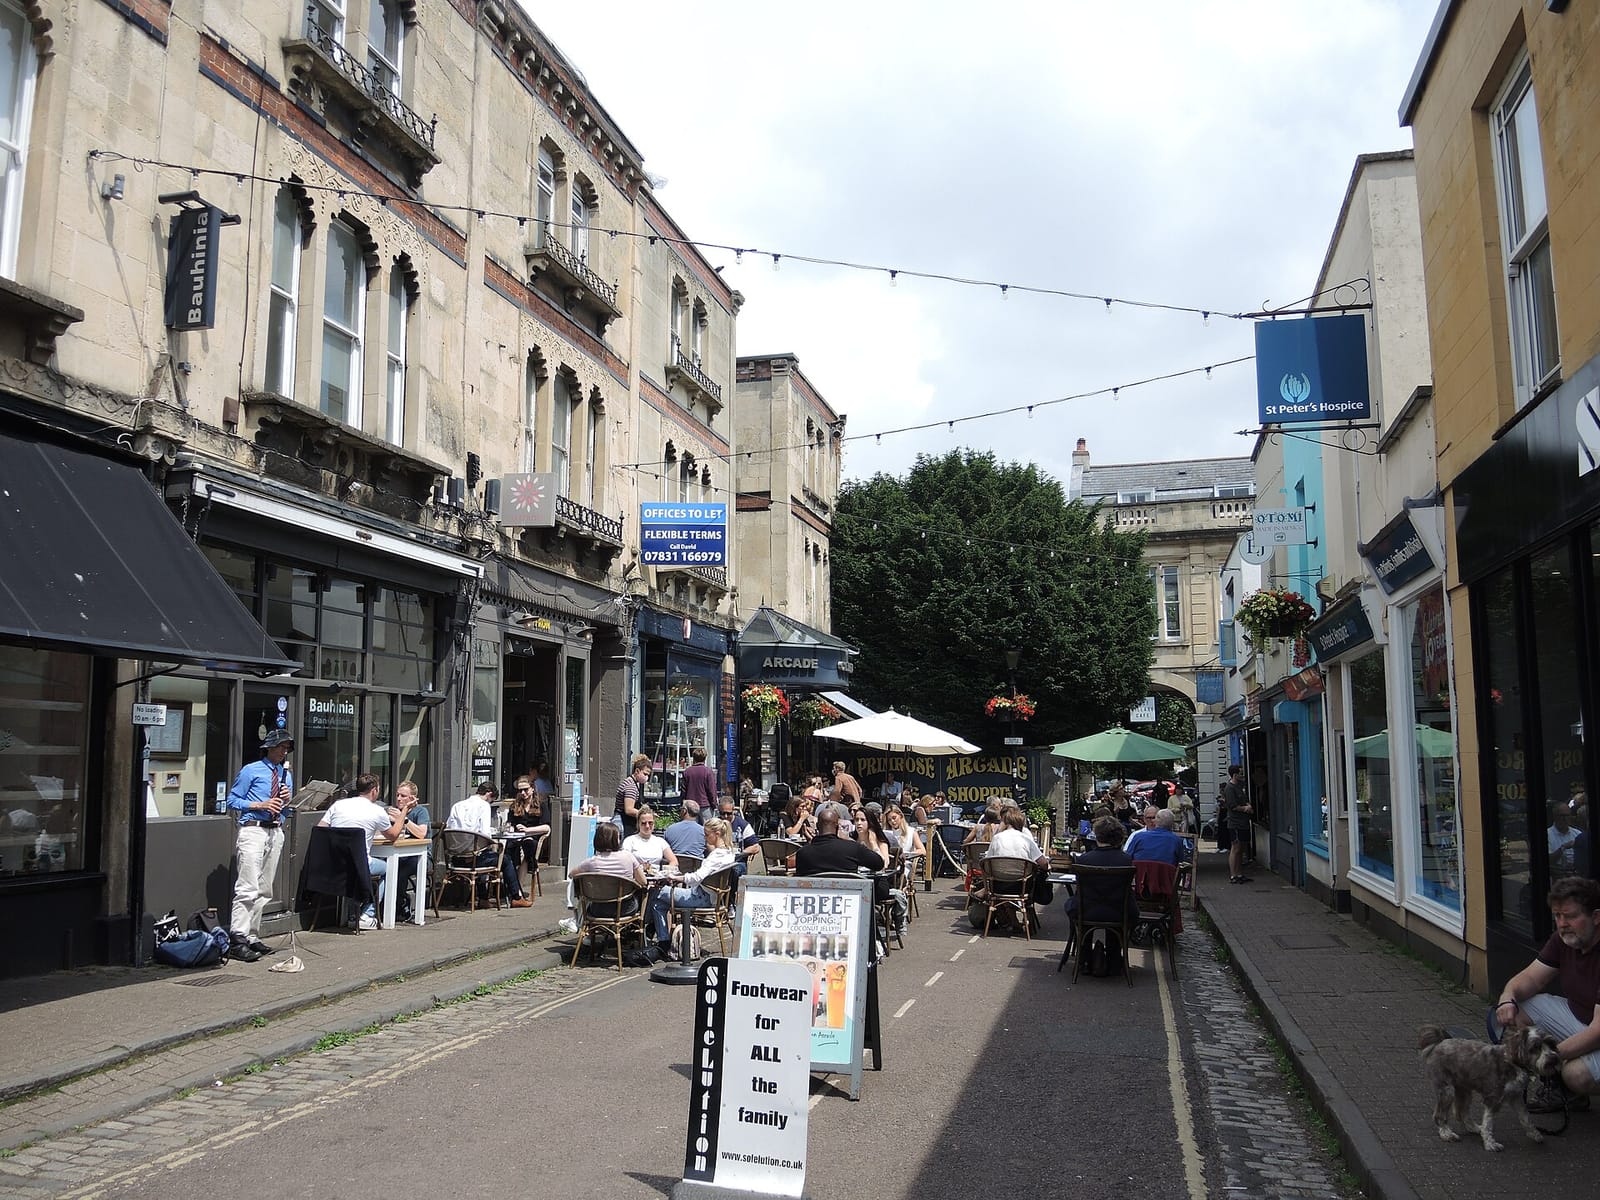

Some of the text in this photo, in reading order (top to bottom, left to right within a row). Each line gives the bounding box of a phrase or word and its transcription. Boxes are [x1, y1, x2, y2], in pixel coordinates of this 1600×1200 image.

[188, 212, 208, 324] Bauhinia
[1265, 400, 1364, 415] St Peter's Hospice
[644, 508, 723, 519] OFFICES TO LET
[645, 530, 722, 540] FLEXIBLE TERMS
[644, 551, 722, 562] 07831 166979
[762, 656, 819, 670] ARCADE
[145, 706, 163, 714] loading
[309, 697, 354, 715] Bauhinia
[1218, 738, 1227, 778] VILLAG
[946, 756, 1028, 781] ARCADE
[790, 896, 843, 915] FREE
[731, 980, 808, 1002] Footwear
[755, 1013, 780, 1031] for
[750, 1045, 782, 1063] ALL
[752, 1076, 778, 1094] the
[738, 1107, 788, 1130] family
[721, 1150, 804, 1170] www.solelution.co.uk
